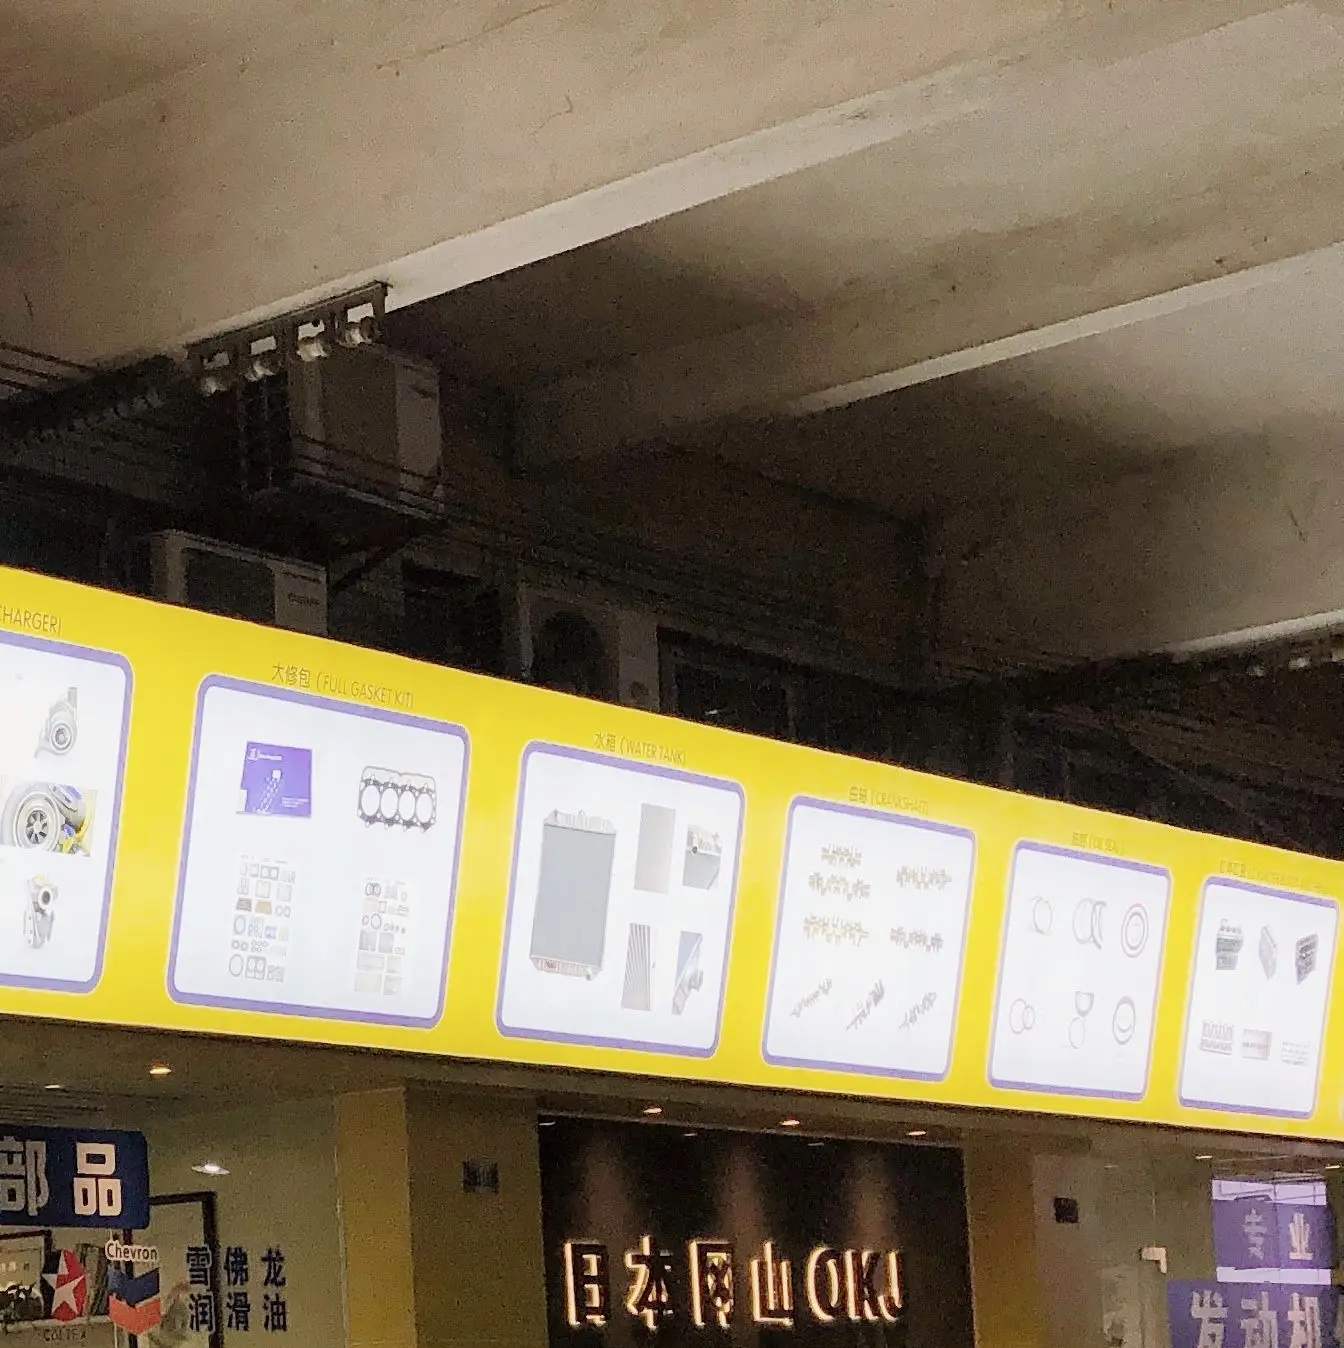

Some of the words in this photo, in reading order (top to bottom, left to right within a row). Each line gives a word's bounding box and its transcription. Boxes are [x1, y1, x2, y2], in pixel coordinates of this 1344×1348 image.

[105, 1241, 158, 1261] Chevron
[186, 1245, 287, 1287] 雪佛龙
[188, 1291, 288, 1333] 润滑油
